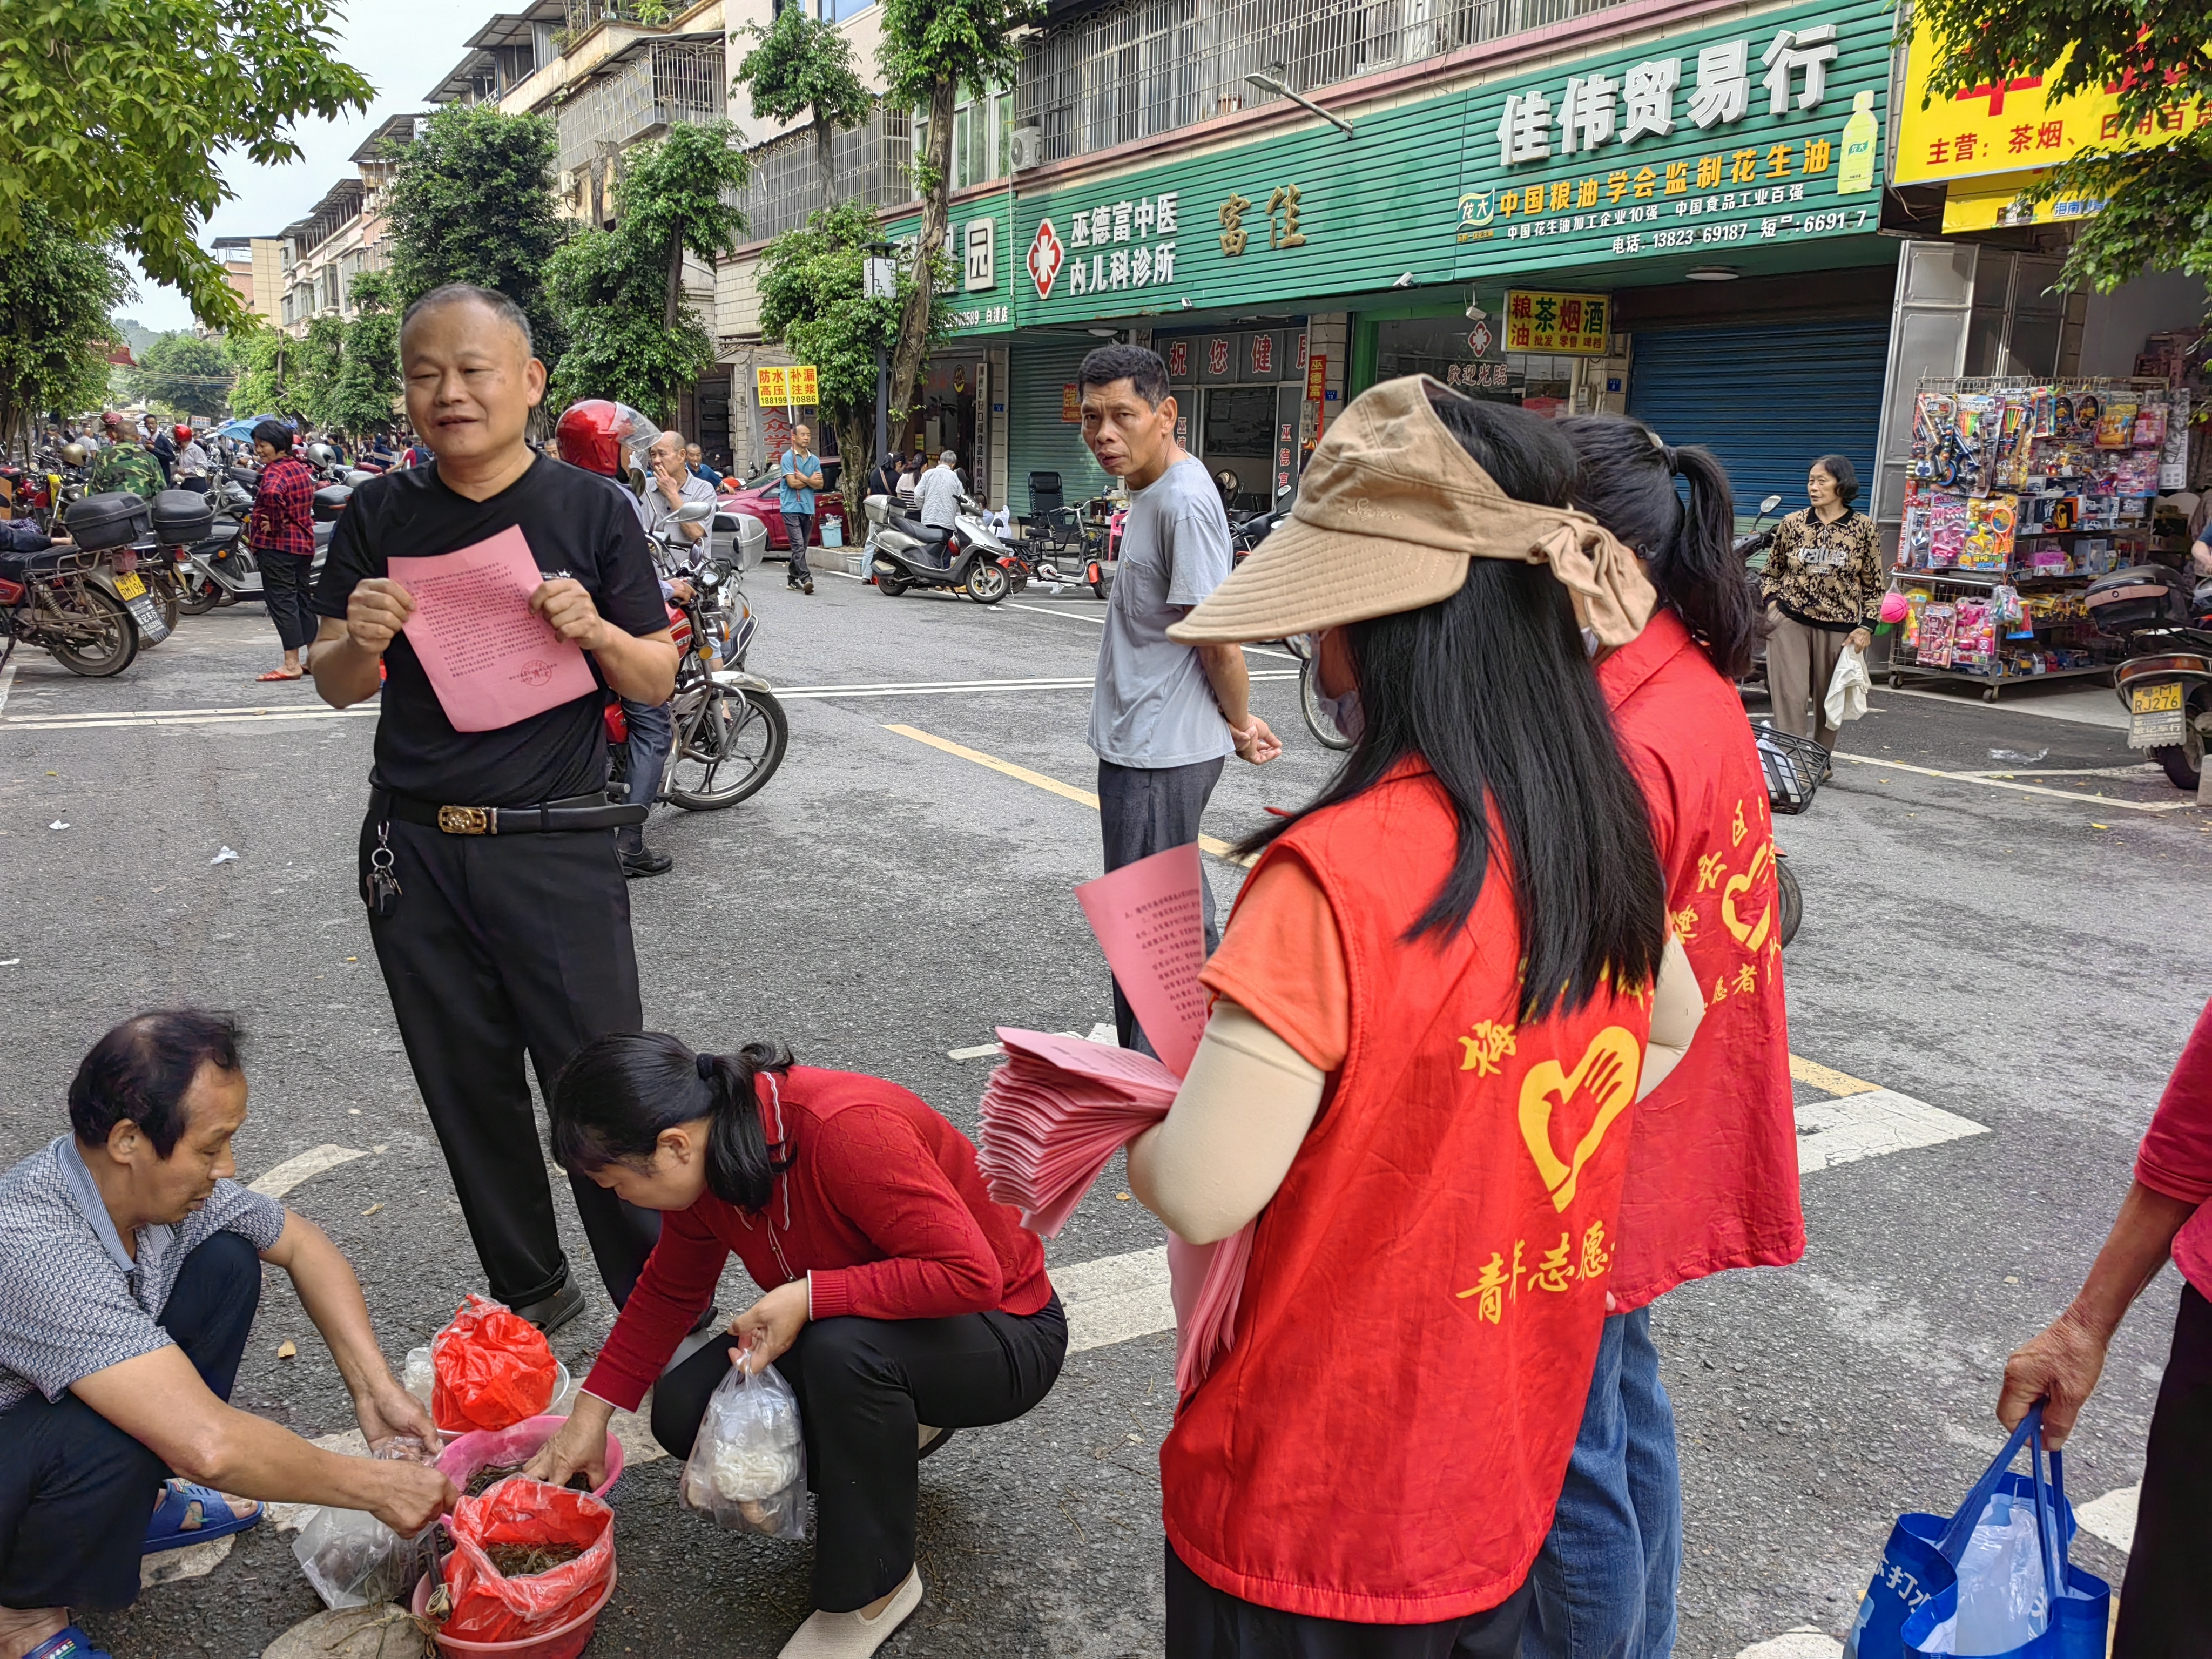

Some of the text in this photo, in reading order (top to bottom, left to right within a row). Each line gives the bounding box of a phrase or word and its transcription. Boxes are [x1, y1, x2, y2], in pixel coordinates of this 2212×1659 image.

[1496, 24, 1838, 166] 佳伟贸易行
[1500, 138, 1831, 219] 中国粮油学会监制花生油
[1071, 192, 1178, 248] 巫德富中医
[1462, 198, 1489, 220] 龙大
[1507, 184, 1804, 241] 中国花生油加工企业10强 中国食品工业百强
[1653, 222, 1748, 248] 1382369187
[1070, 241, 1176, 296] 内儿科诊所
[986, 305, 1008, 323] 白渡店
[1310, 360, 1323, 402] 巫德富
[2135, 696, 2179, 712] RJ276
